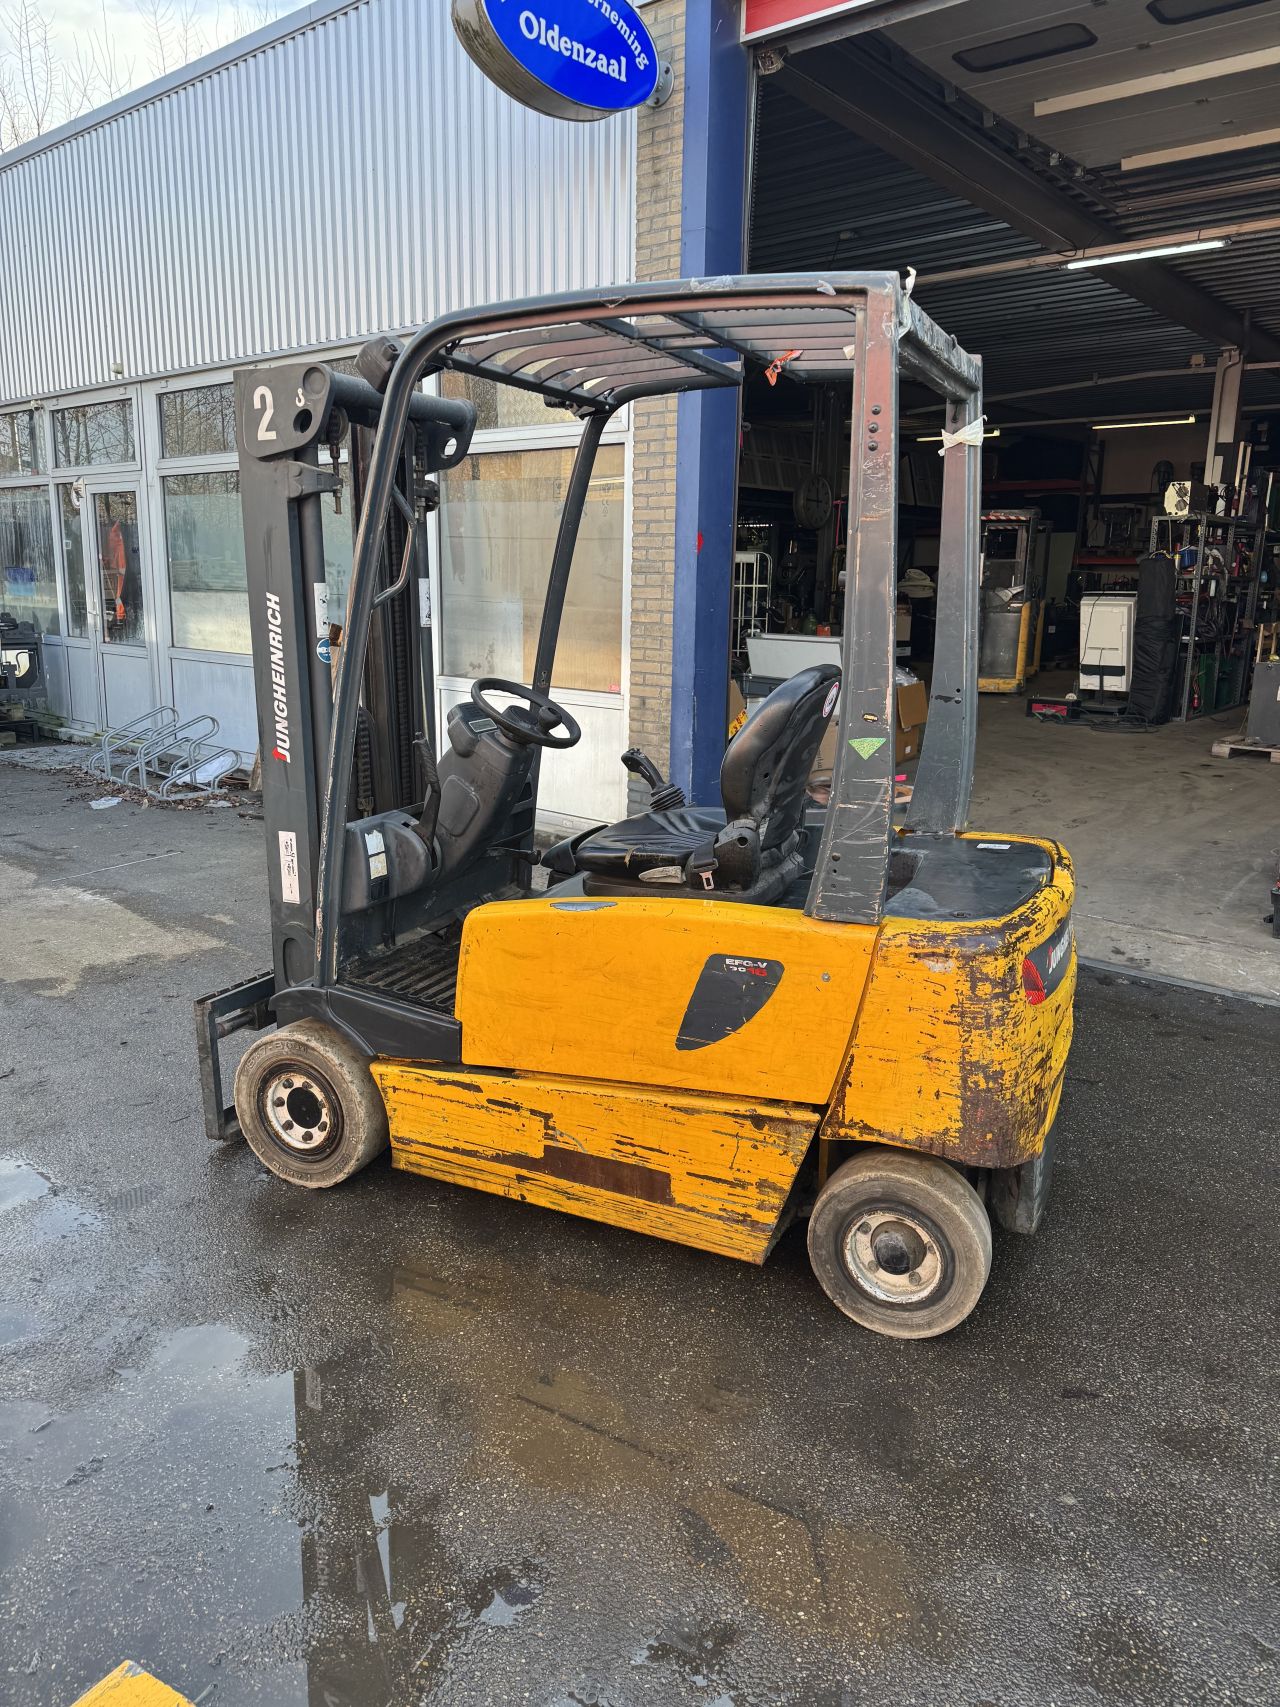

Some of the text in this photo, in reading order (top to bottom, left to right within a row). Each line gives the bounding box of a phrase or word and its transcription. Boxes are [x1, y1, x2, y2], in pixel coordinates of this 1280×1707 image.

[519, 10, 627, 83] Oldenzaal
[253, 385, 277, 441] 2
[266, 591, 291, 764] JUNGHEINRICH
